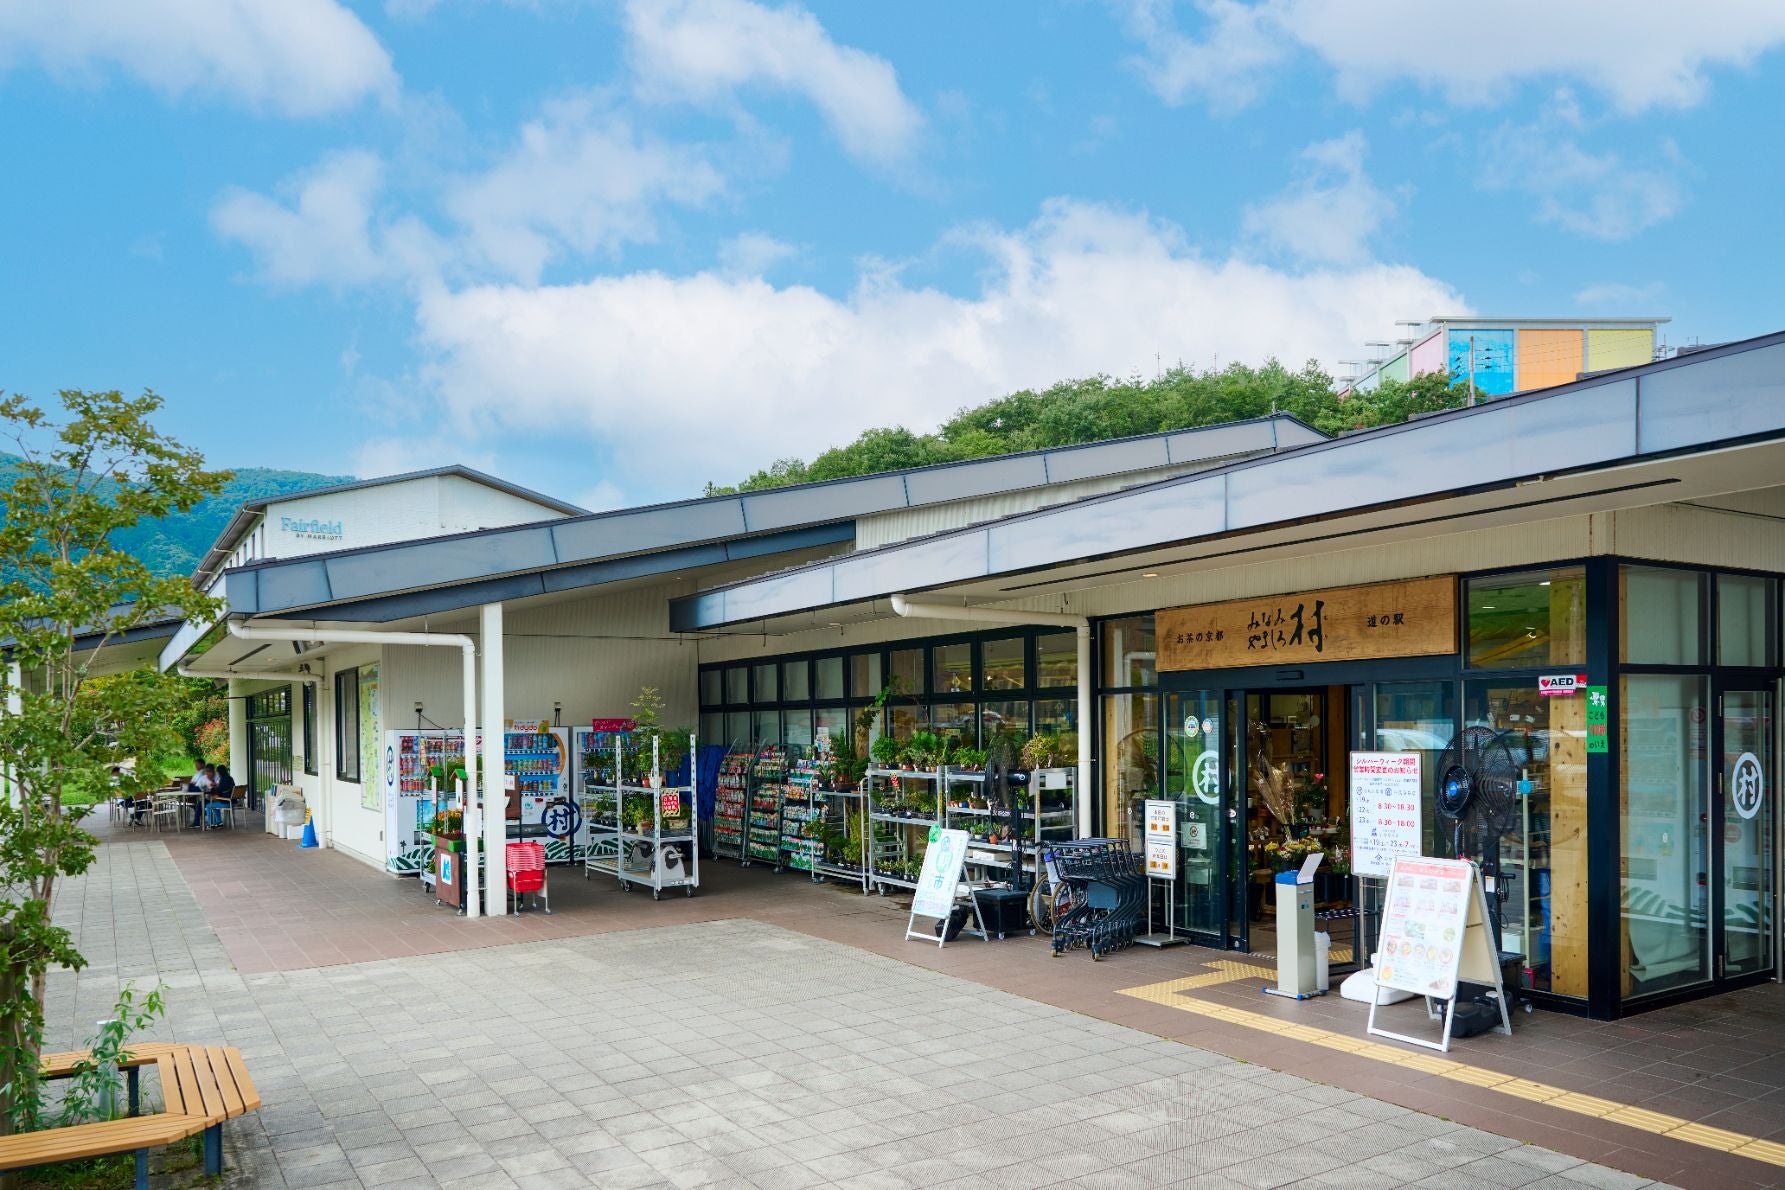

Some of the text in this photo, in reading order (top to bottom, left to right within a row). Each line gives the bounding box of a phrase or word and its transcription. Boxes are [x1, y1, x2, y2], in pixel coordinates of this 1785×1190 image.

[281, 517, 343, 534] Fairfield
[1248, 608, 1286, 631] みなみ
[1289, 600, 1325, 652] 村
[1367, 613, 1405, 628] 道の駅
[1176, 630, 1225, 645] お茶の京都
[1248, 629, 1287, 650] やましろ
[1550, 677, 1574, 686] AED
[1589, 711, 1605, 720] こども
[1589, 740, 1606, 749] のいえ
[1737, 765, 1758, 806] 村
[549, 808, 571, 834] 村
